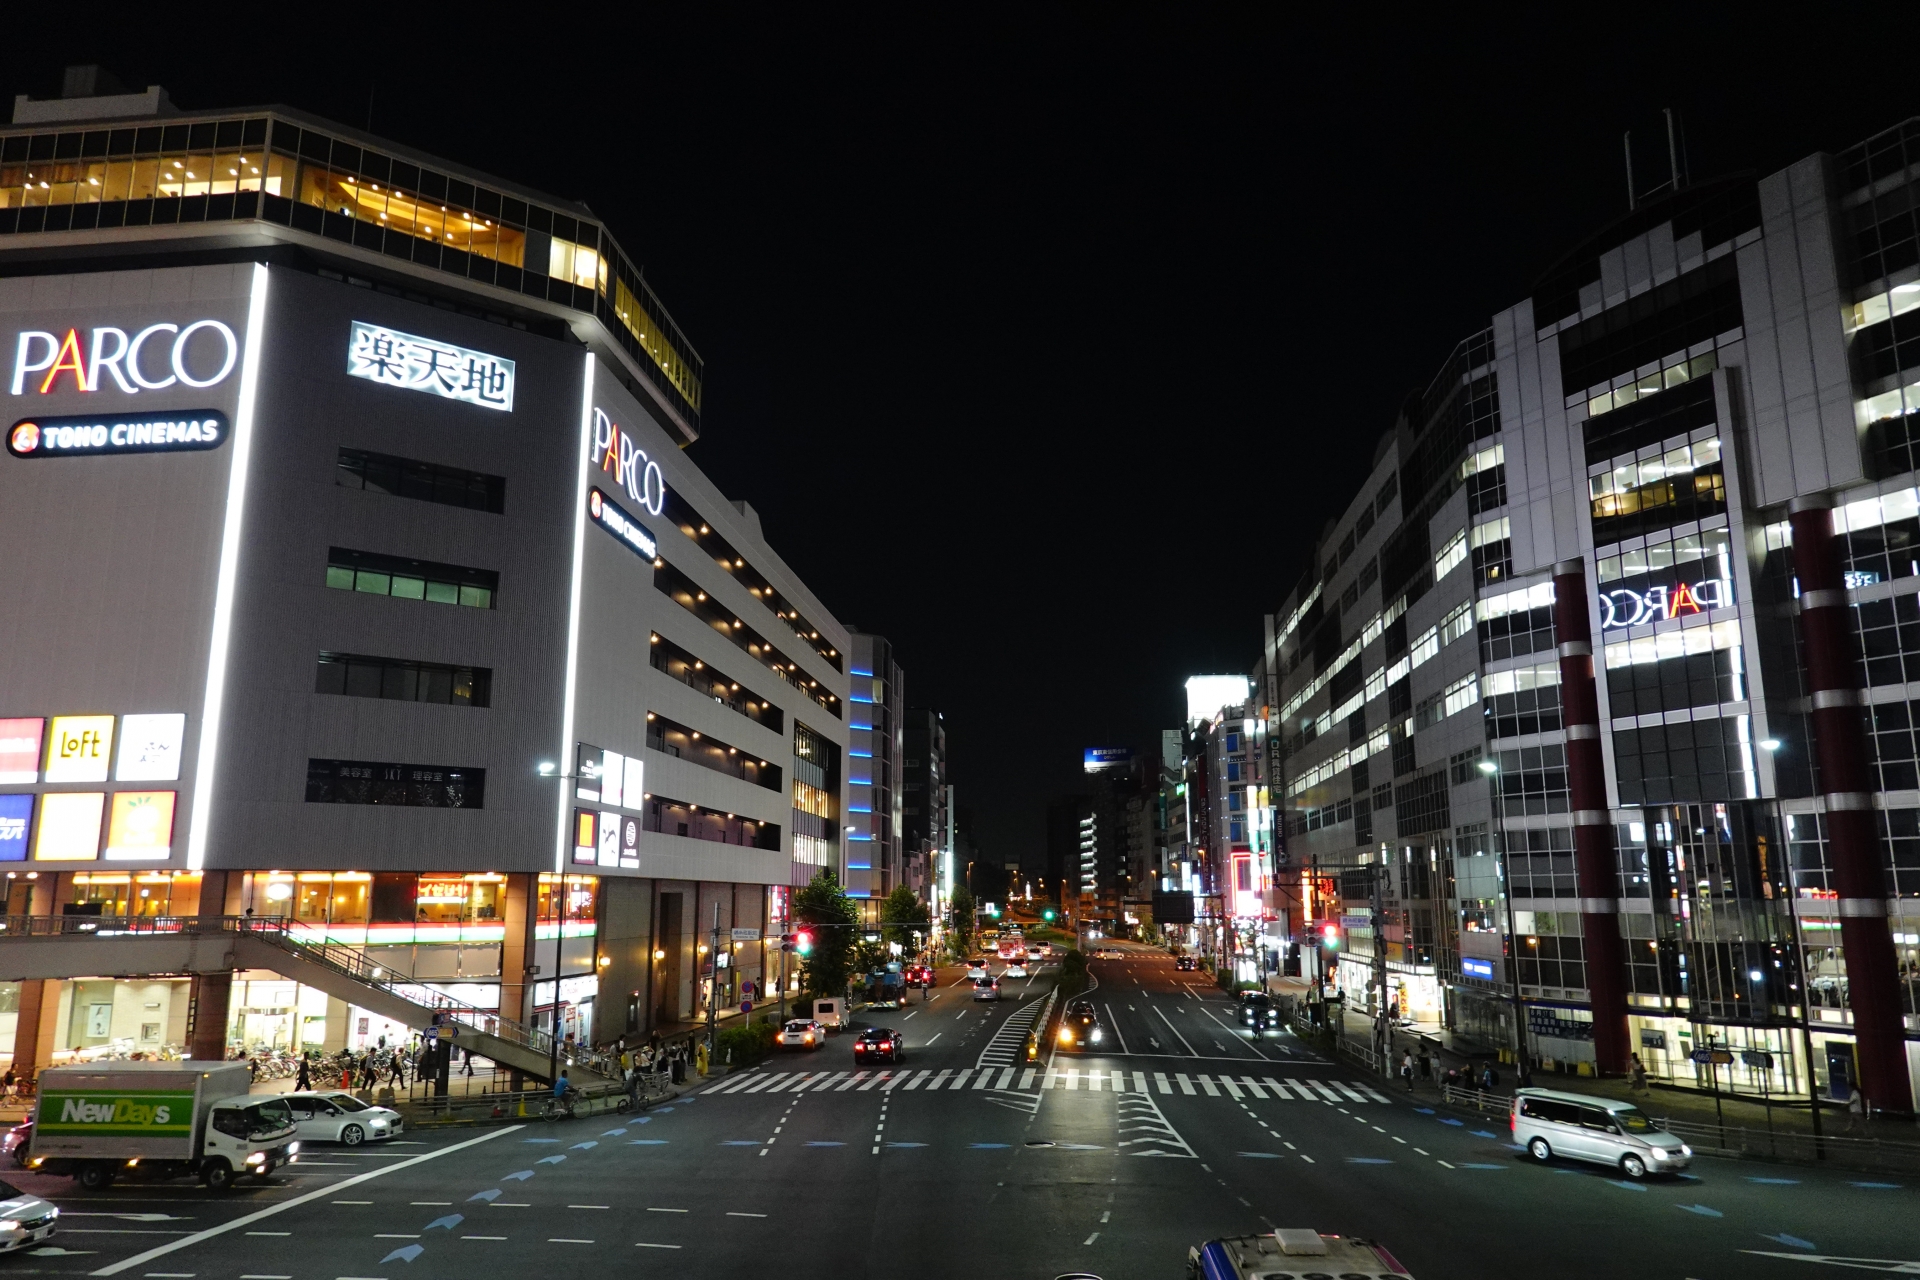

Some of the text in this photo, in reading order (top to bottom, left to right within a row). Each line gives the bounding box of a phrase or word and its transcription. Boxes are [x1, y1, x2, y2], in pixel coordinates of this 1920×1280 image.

[10, 319, 238, 396] PARCO
[355, 328, 508, 405] 楽天地
[44, 419, 218, 449] TOHO CINEMAS
[591, 406, 664, 516] PARCO
[601, 501, 657, 560] TOHO CINEMAS
[340, 767, 373, 779] 美容室
[412, 771, 444, 783] 理容室
[60, 1099, 171, 1125] NewDays
